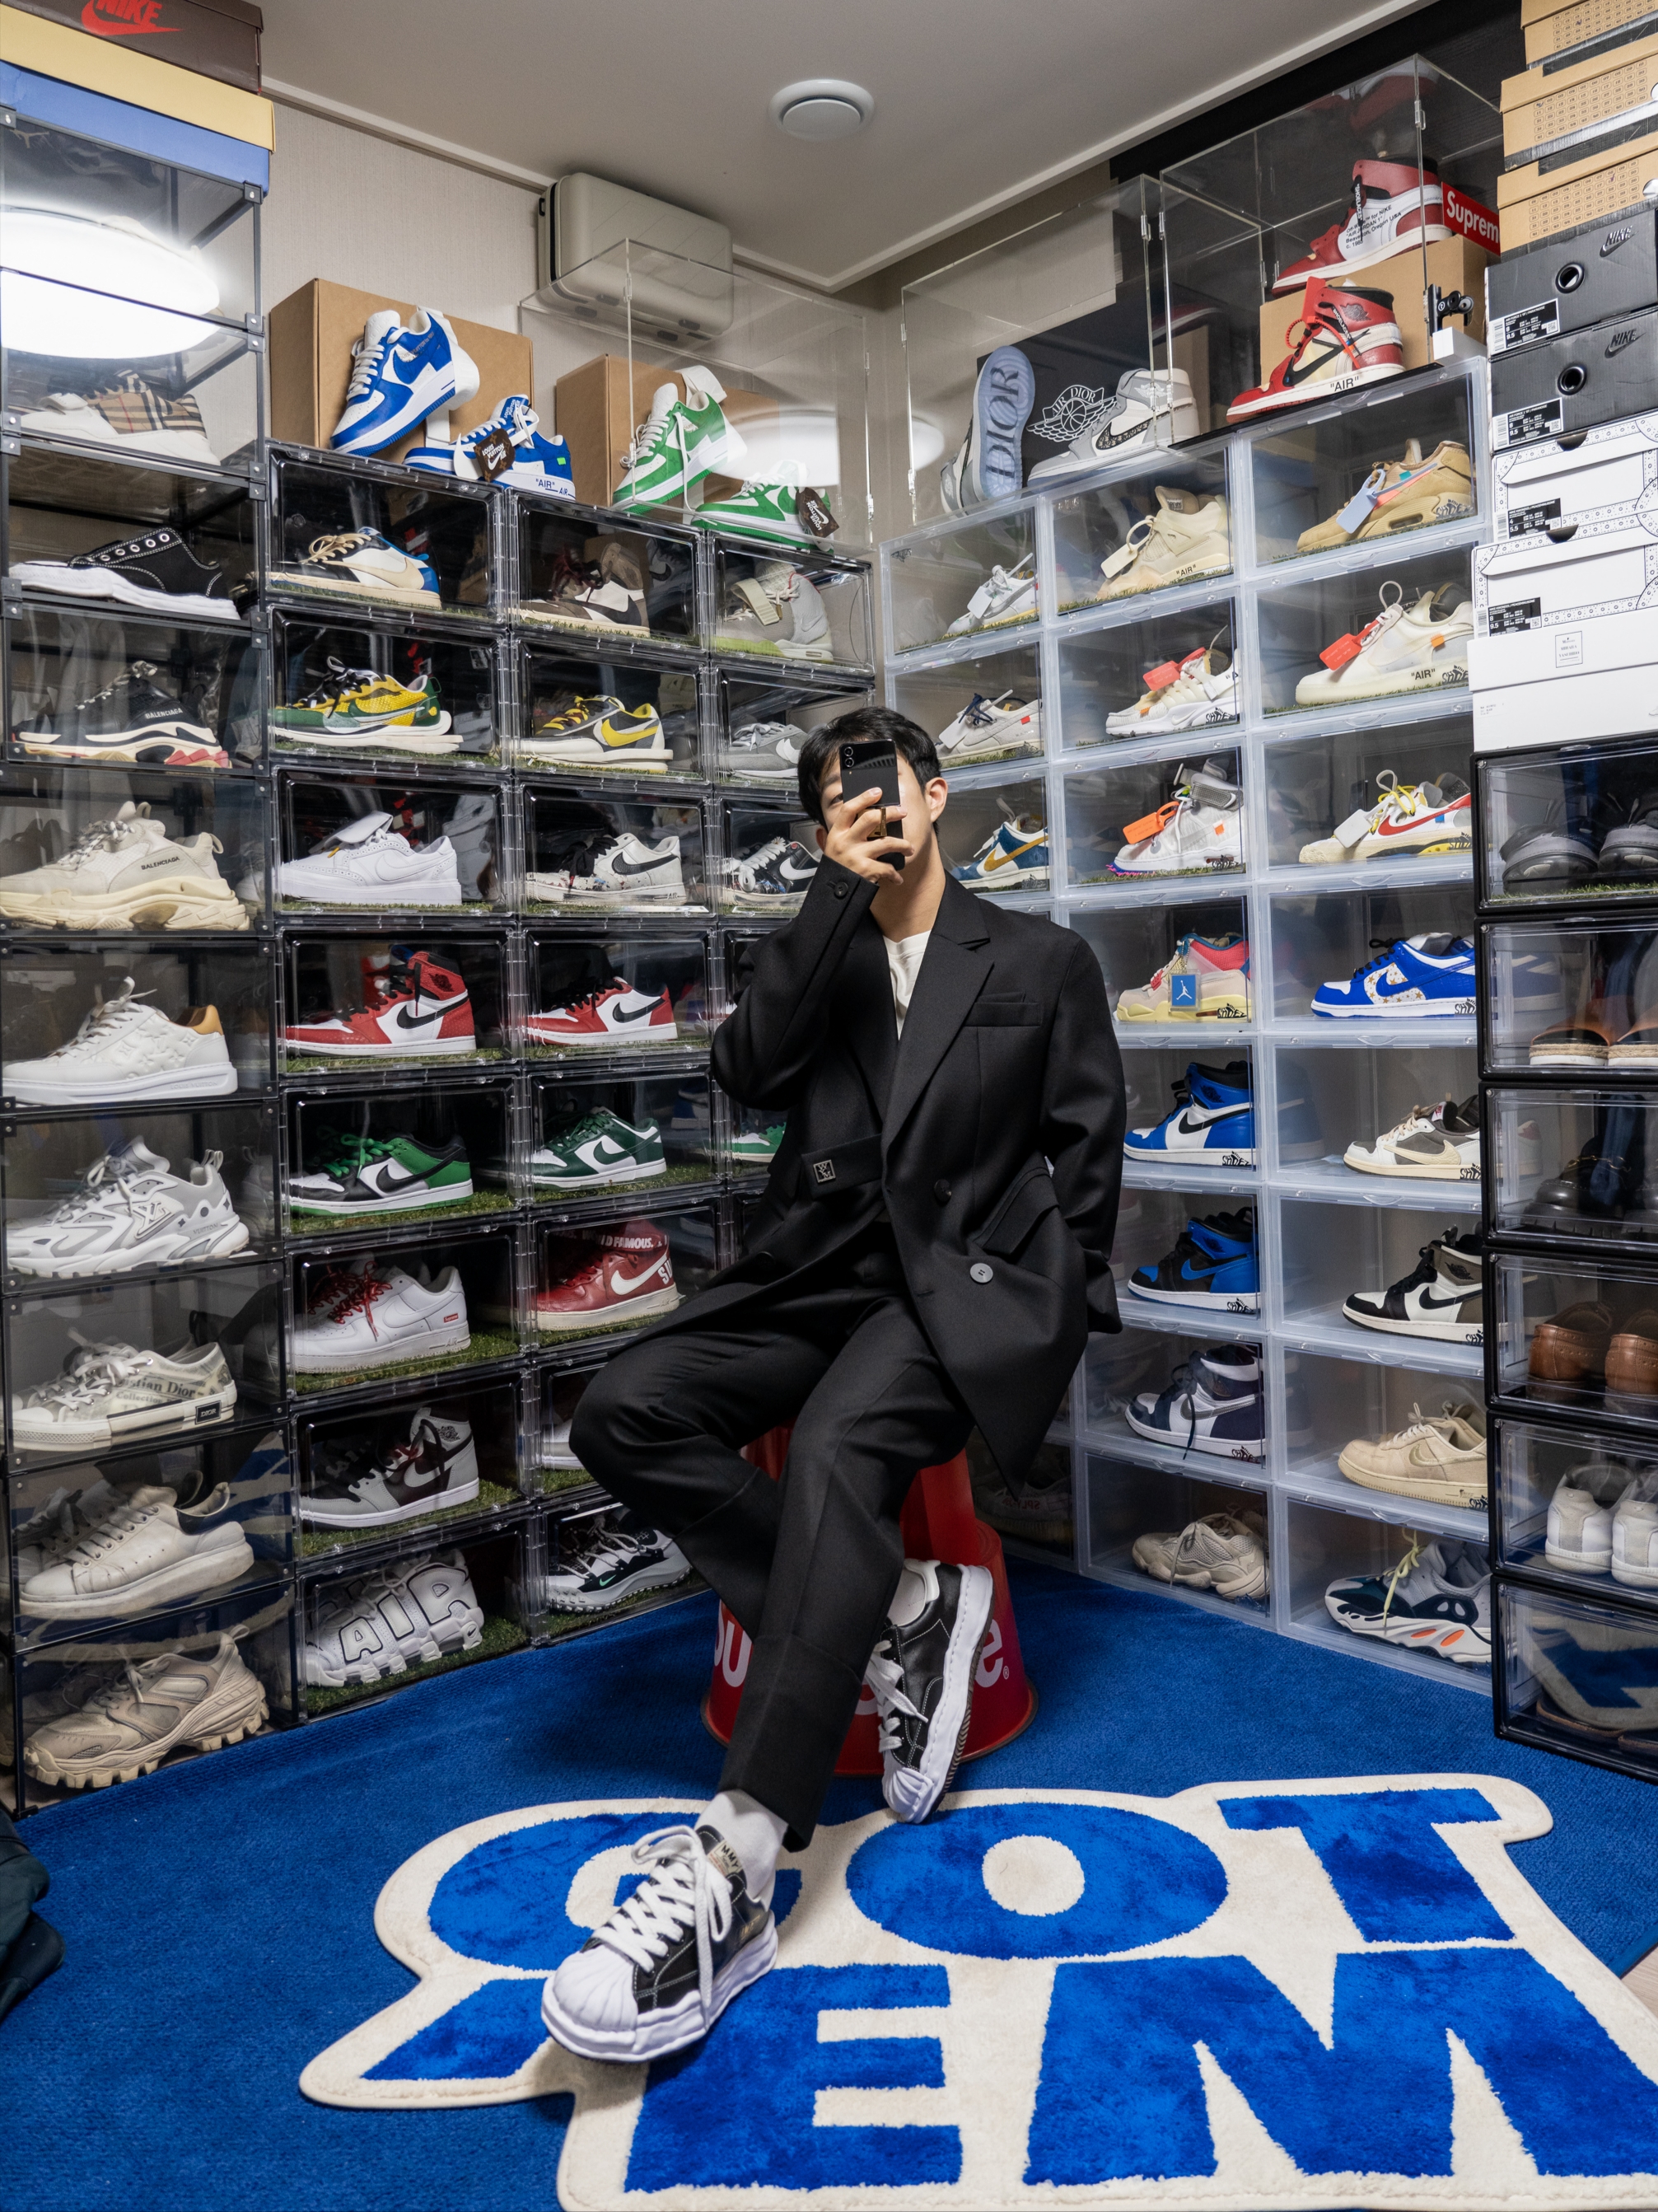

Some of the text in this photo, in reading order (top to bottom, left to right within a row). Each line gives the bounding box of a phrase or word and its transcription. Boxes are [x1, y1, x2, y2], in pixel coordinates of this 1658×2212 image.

[1446, 190, 1499, 244] Suprem
[1605, 225, 1632, 246] NIKE
[1610, 328, 1637, 348] NIKE
[1330, 376, 1359, 392] "AIR"
[1052, 386, 1095, 418] AIR DIOR
[985, 367, 1019, 478] DIOR
[482, 443, 494, 456] LOUIS
[535, 478, 555, 489] "AIR"
[558, 487, 568, 496] AIR
[1175, 564, 1196, 577] "AIR"
[1411, 668, 1436, 680] "AIR"
[1441, 665, 1469, 683] SHOE
[145, 708, 183, 719] BALENCIAGA
[141, 855, 180, 870] BALENCIAGA
[1455, 998, 1476, 1014] SHO
[193, 1223, 218, 1235] VUITTON
[614, 1236, 654, 1249] FAMOUS.
[166, 1381, 196, 1397] Dior
[200, 1408, 217, 1418] DIOR
[339, 1562, 472, 1665] AIR
[721, 1844, 739, 1868] MMY
